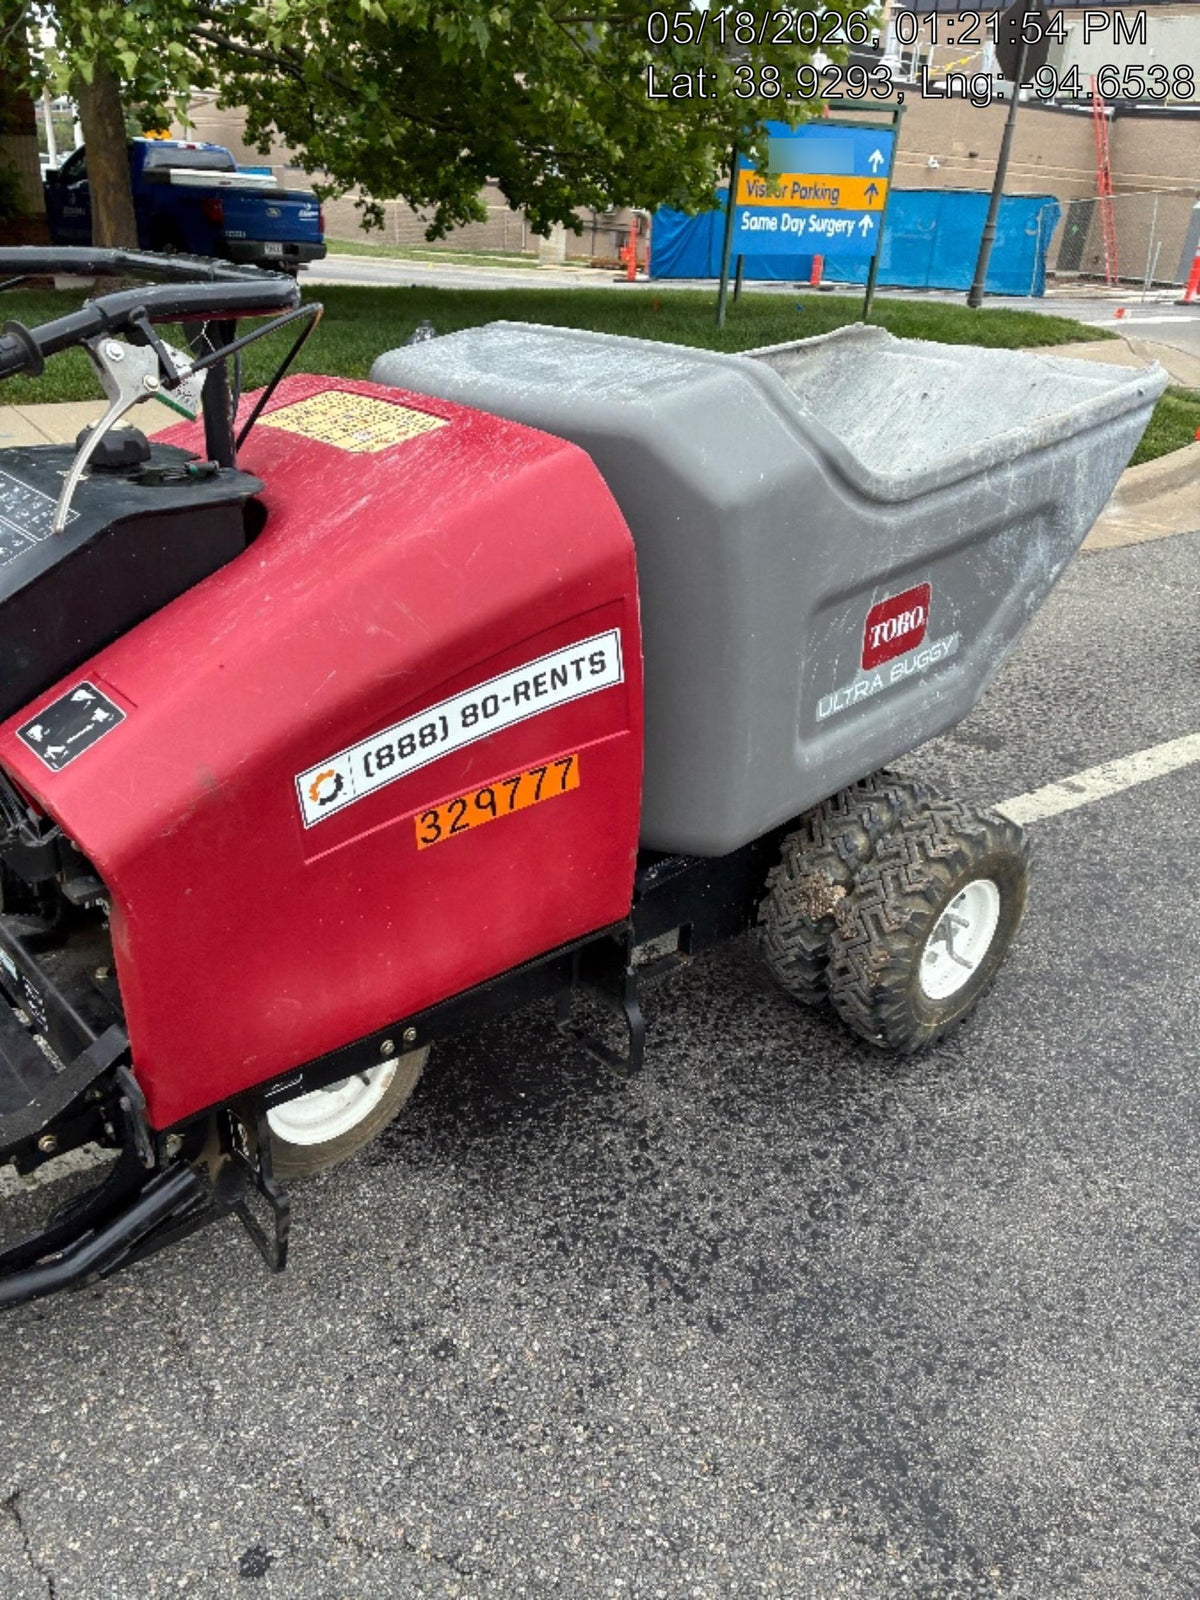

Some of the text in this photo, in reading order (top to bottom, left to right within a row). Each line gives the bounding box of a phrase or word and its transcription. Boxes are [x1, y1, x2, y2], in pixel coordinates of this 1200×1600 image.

[740, 211, 856, 238] Same Day Surgery
[791, 181, 840, 206] Parking
[870, 605, 924, 650] TORO
[818, 634, 958, 719] ULTRA BUGGY
[363, 650, 607, 777] (888) 80-RENTS
[420, 756, 573, 846] 329777
